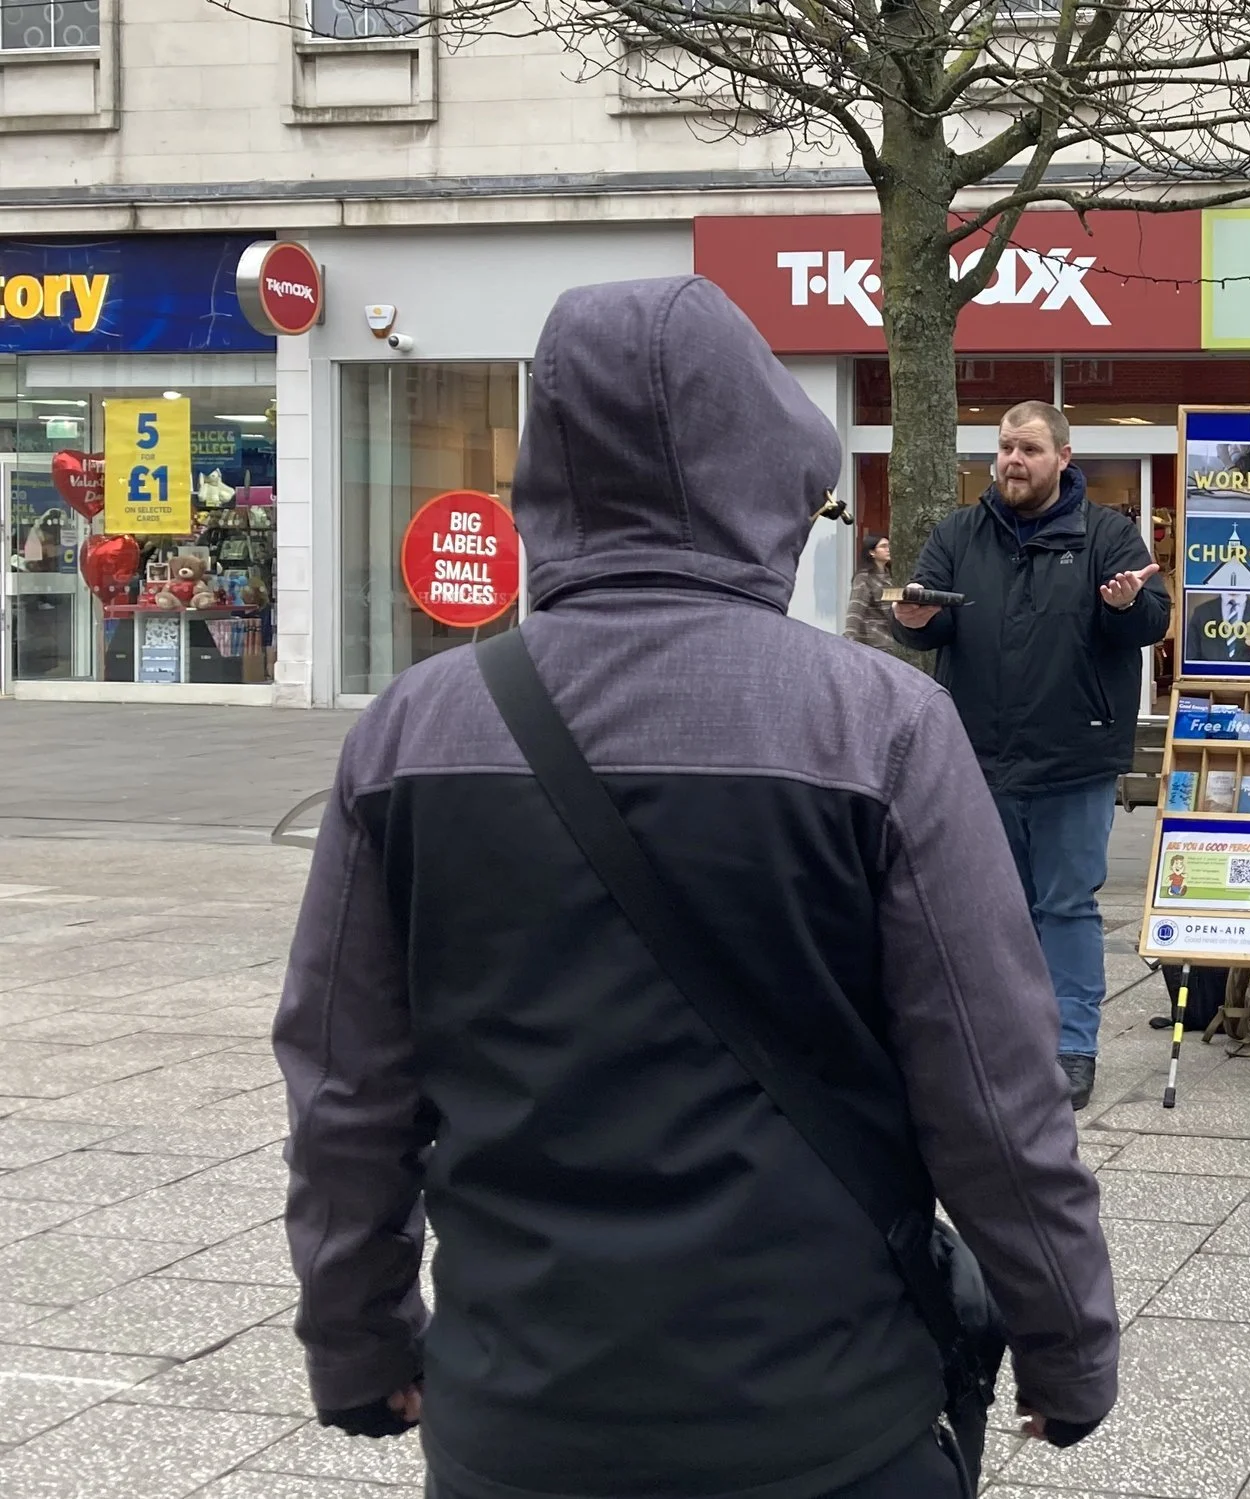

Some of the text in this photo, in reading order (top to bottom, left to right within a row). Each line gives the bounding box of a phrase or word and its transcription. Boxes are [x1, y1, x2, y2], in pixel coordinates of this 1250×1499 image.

[0, 274, 109, 332] ory
[136, 413, 159, 449] 5
[191, 443, 236, 455] OLLECT
[69, 474, 105, 487] Valent
[128, 465, 168, 501] £1
[450, 511, 482, 533] BIG
[432, 532, 497, 556] LABELS
[434, 559, 491, 583] SMALL
[430, 581, 494, 605] PRICES
[1190, 719, 1221, 732] Free
[1167, 842, 1182, 850] ARE
[1183, 842, 1198, 851] YOU
[1199, 843, 1205, 851] A
[1205, 843, 1228, 851] GOOD
[1185, 925, 1245, 935] OPEN-AIR
